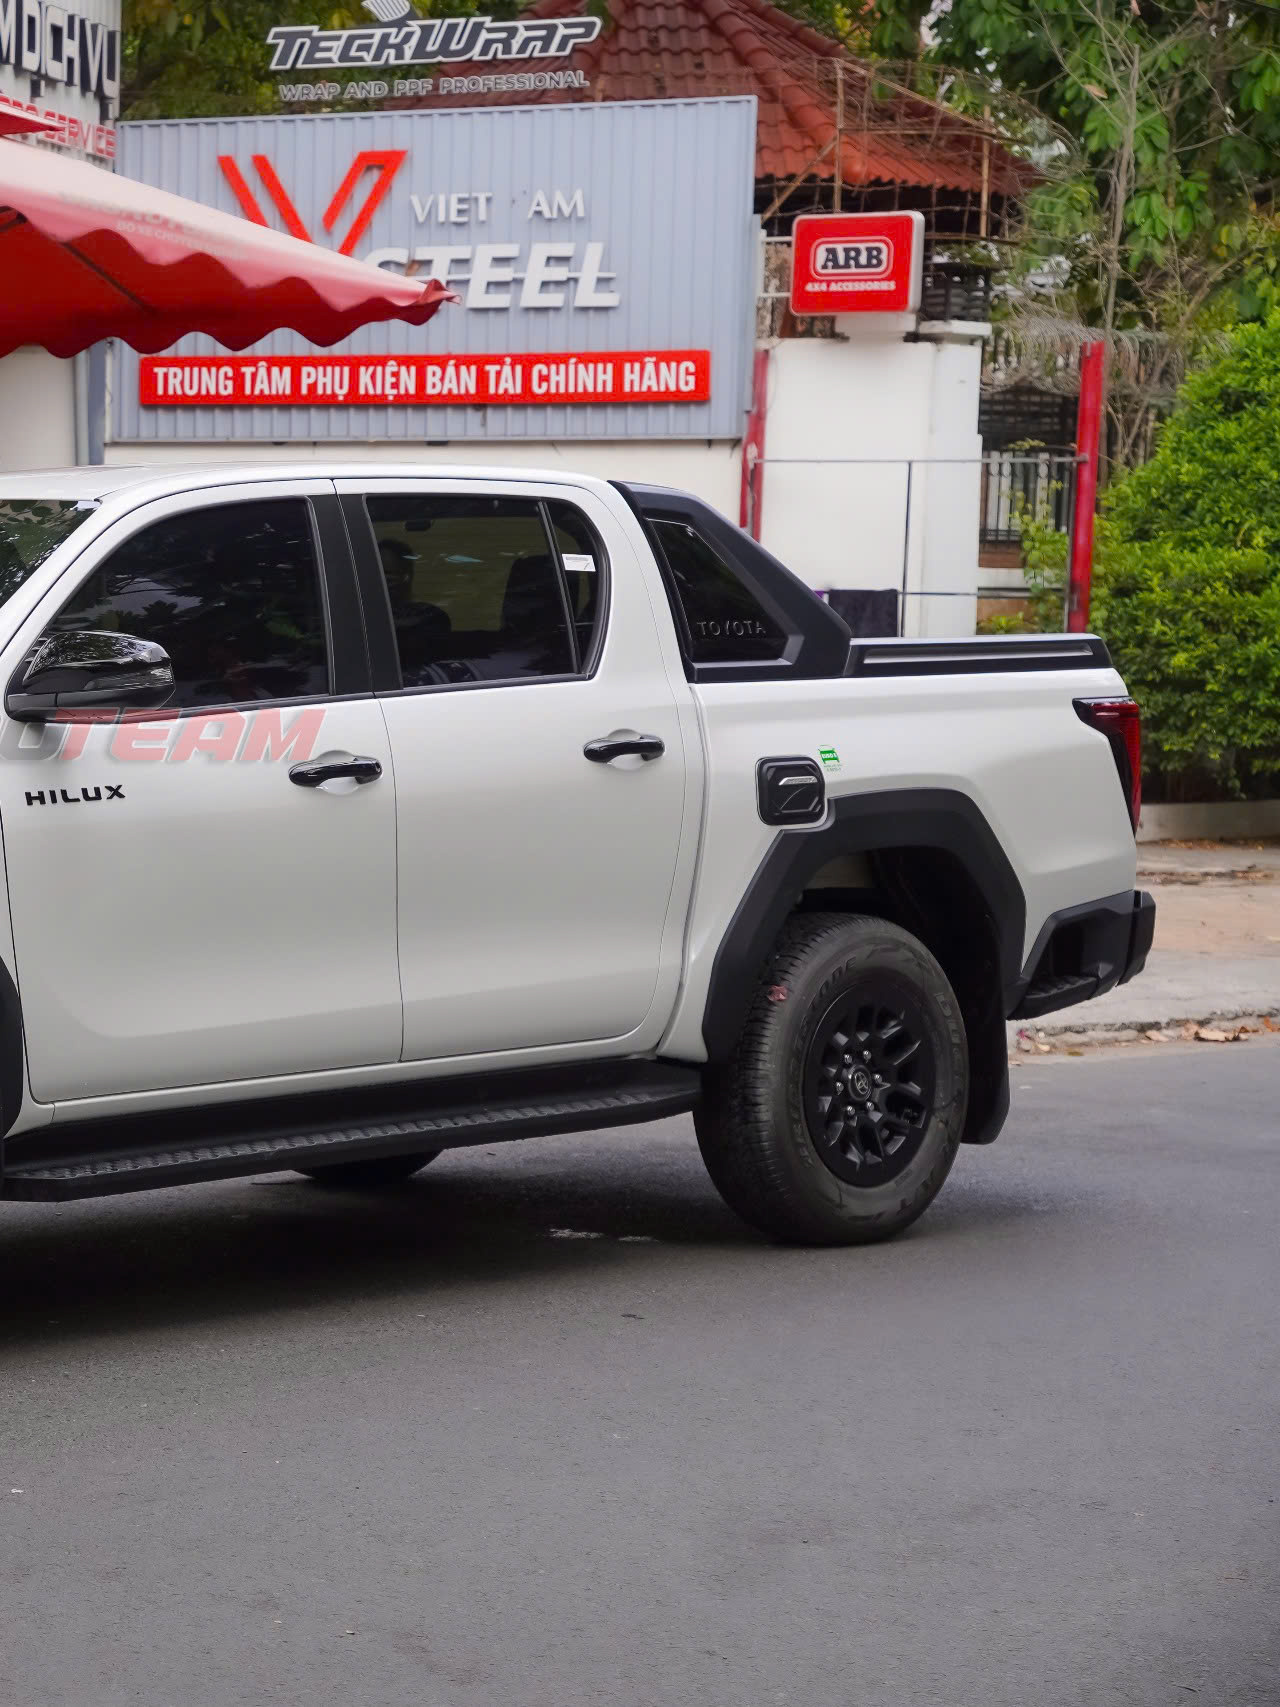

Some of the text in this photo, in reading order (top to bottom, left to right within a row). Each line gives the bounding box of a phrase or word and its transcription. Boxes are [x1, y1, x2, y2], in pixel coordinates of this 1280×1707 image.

[279, 71, 590, 100] WRAP AND PPF PROFESSIONAL
[821, 246, 883, 270] ARB
[829, 280, 896, 292] ACCESSORIES
[153, 357, 697, 400] TRUNG TÂM PHỤ KIỆN BÁN TẢI CHÍNH HÃNG
[697, 620, 767, 635] TOYOTA
[25, 785, 126, 806] HILUX
